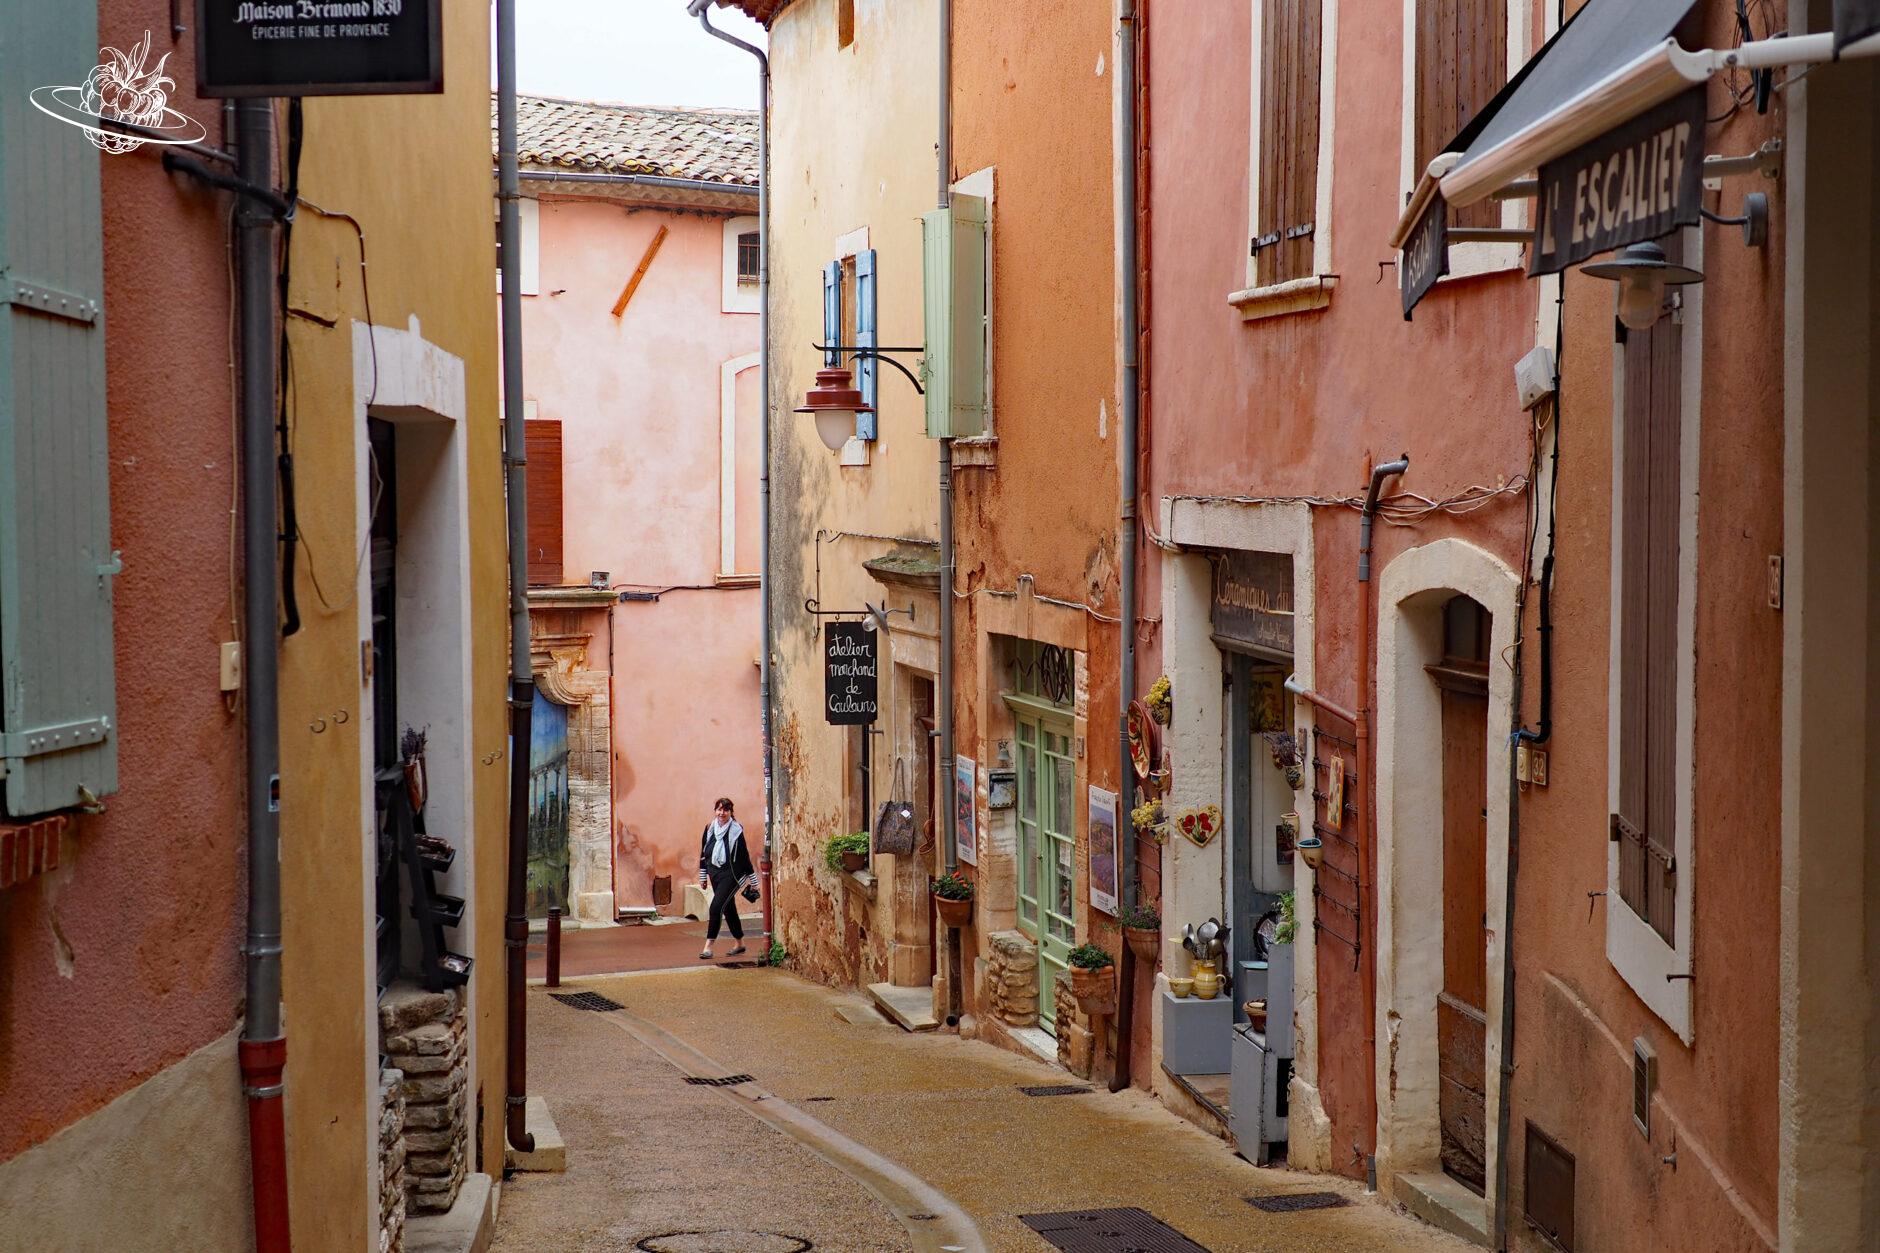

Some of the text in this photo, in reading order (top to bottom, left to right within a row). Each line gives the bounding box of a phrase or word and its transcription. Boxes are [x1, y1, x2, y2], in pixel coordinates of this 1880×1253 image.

[233, 0, 402, 23] Maison Brémond 1830
[252, 23, 389, 40] ÉPICERIE FINE DE PROVENCE
[829, 634, 872, 657] atelier
[829, 658, 876, 678] marchand
[846, 678, 862, 695] de
